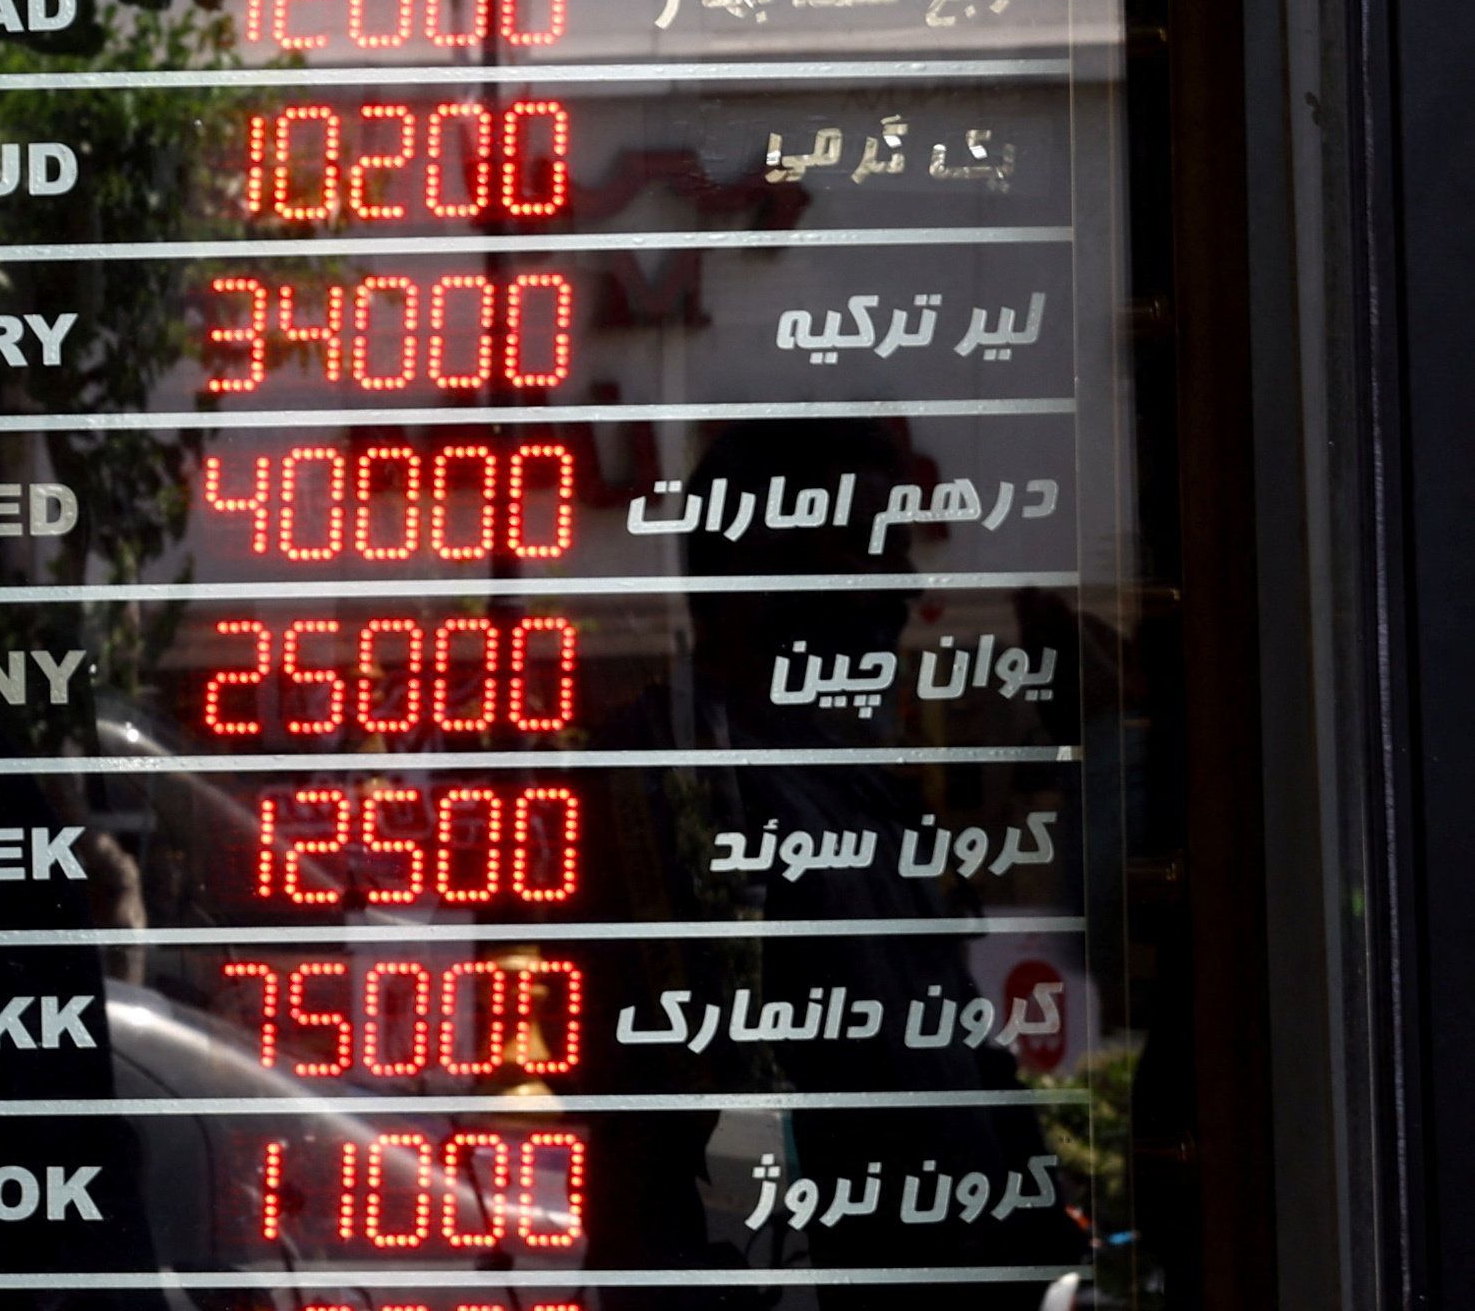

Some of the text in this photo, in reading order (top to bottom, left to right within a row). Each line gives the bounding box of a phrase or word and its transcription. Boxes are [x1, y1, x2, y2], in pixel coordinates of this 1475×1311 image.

[244, 99, 570, 222] 10200
[207, 272, 573, 394] 34000
[776, 292, 1046, 364] لیر ترکیه
[203, 443, 575, 563] 40000
[627, 473, 1059, 555] درهم امارات
[203, 616, 577, 737] 25000
[770, 634, 1057, 719] یوان چین
[256, 786, 580, 906] 12500
[710, 811, 1058, 882] کرون سوئد
[223, 955, 583, 1078] 75000
[616, 982, 1064, 1054] کرون دانمارک
[262, 1131, 586, 1249] 11000
[744, 1153, 1058, 1231] کرون نروژ
